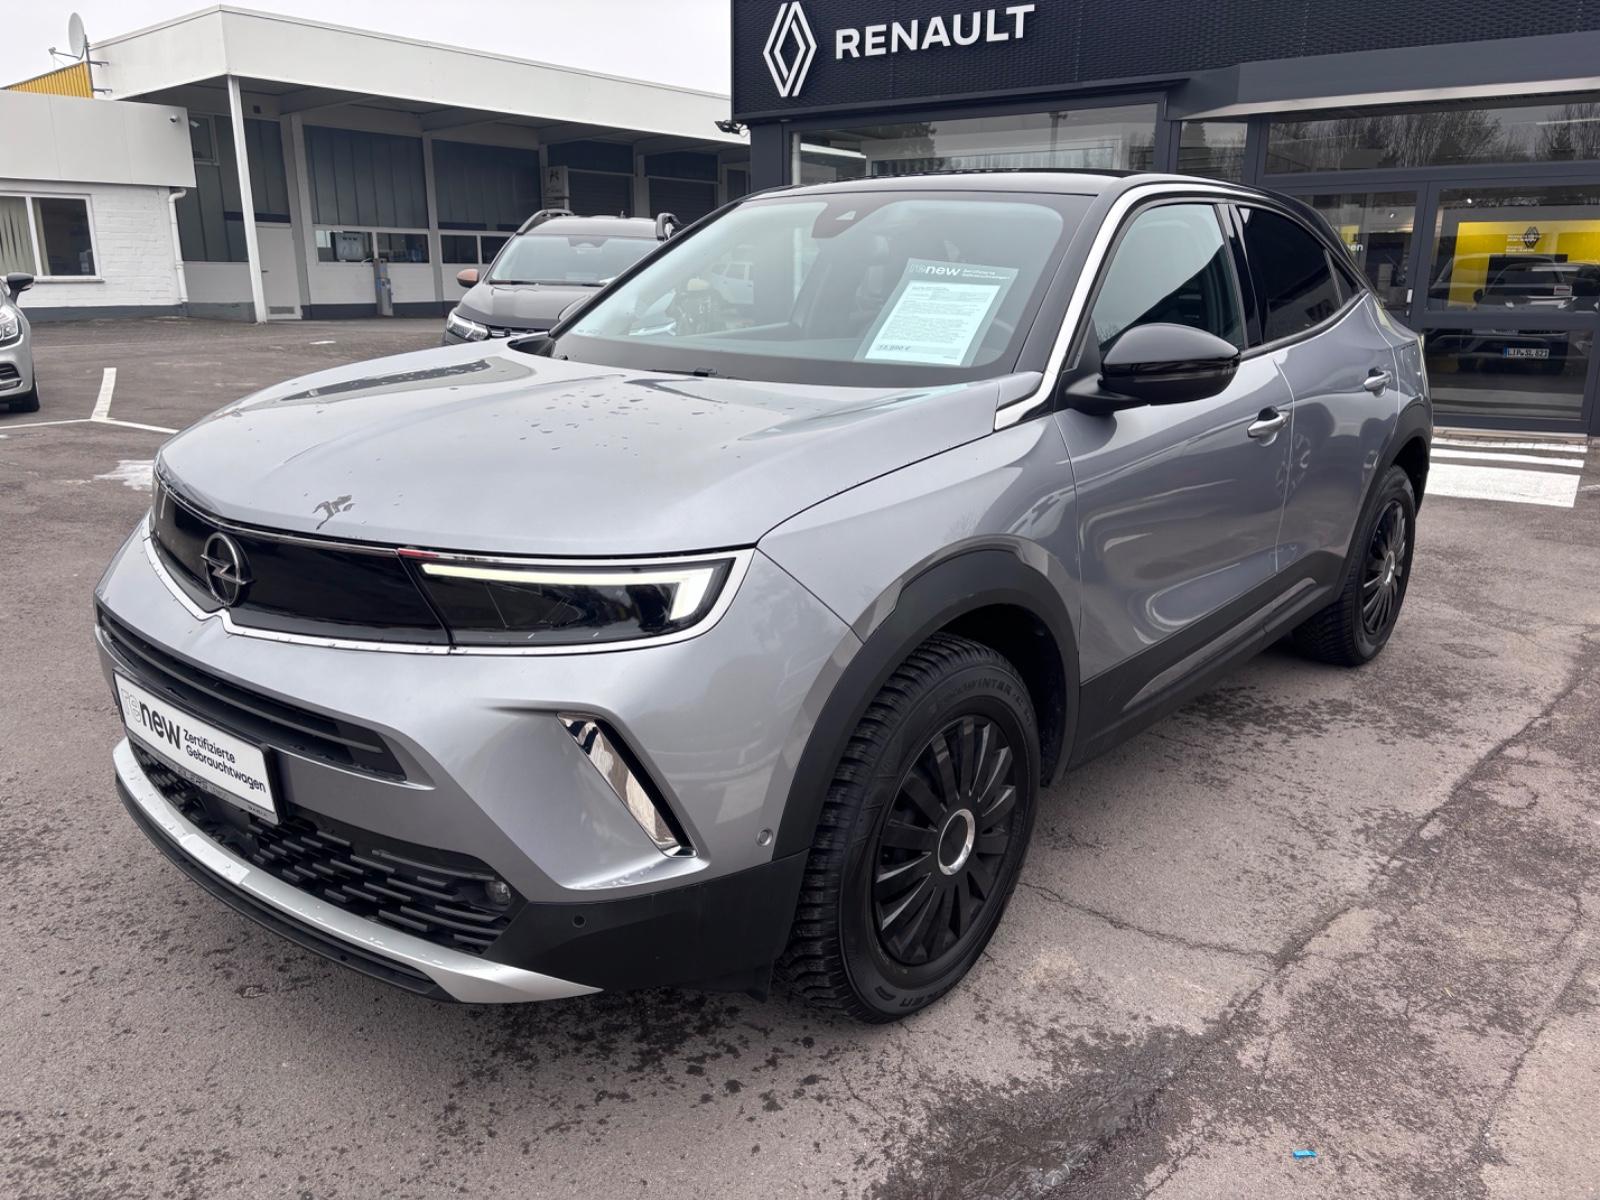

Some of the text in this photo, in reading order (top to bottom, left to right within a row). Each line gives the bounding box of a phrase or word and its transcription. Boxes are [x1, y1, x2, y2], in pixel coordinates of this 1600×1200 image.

[835, 4, 1035, 59] RENAULT
[183, 729, 235, 764] Zertifizierte
[186, 745, 266, 793] Gebrauchtwagen
